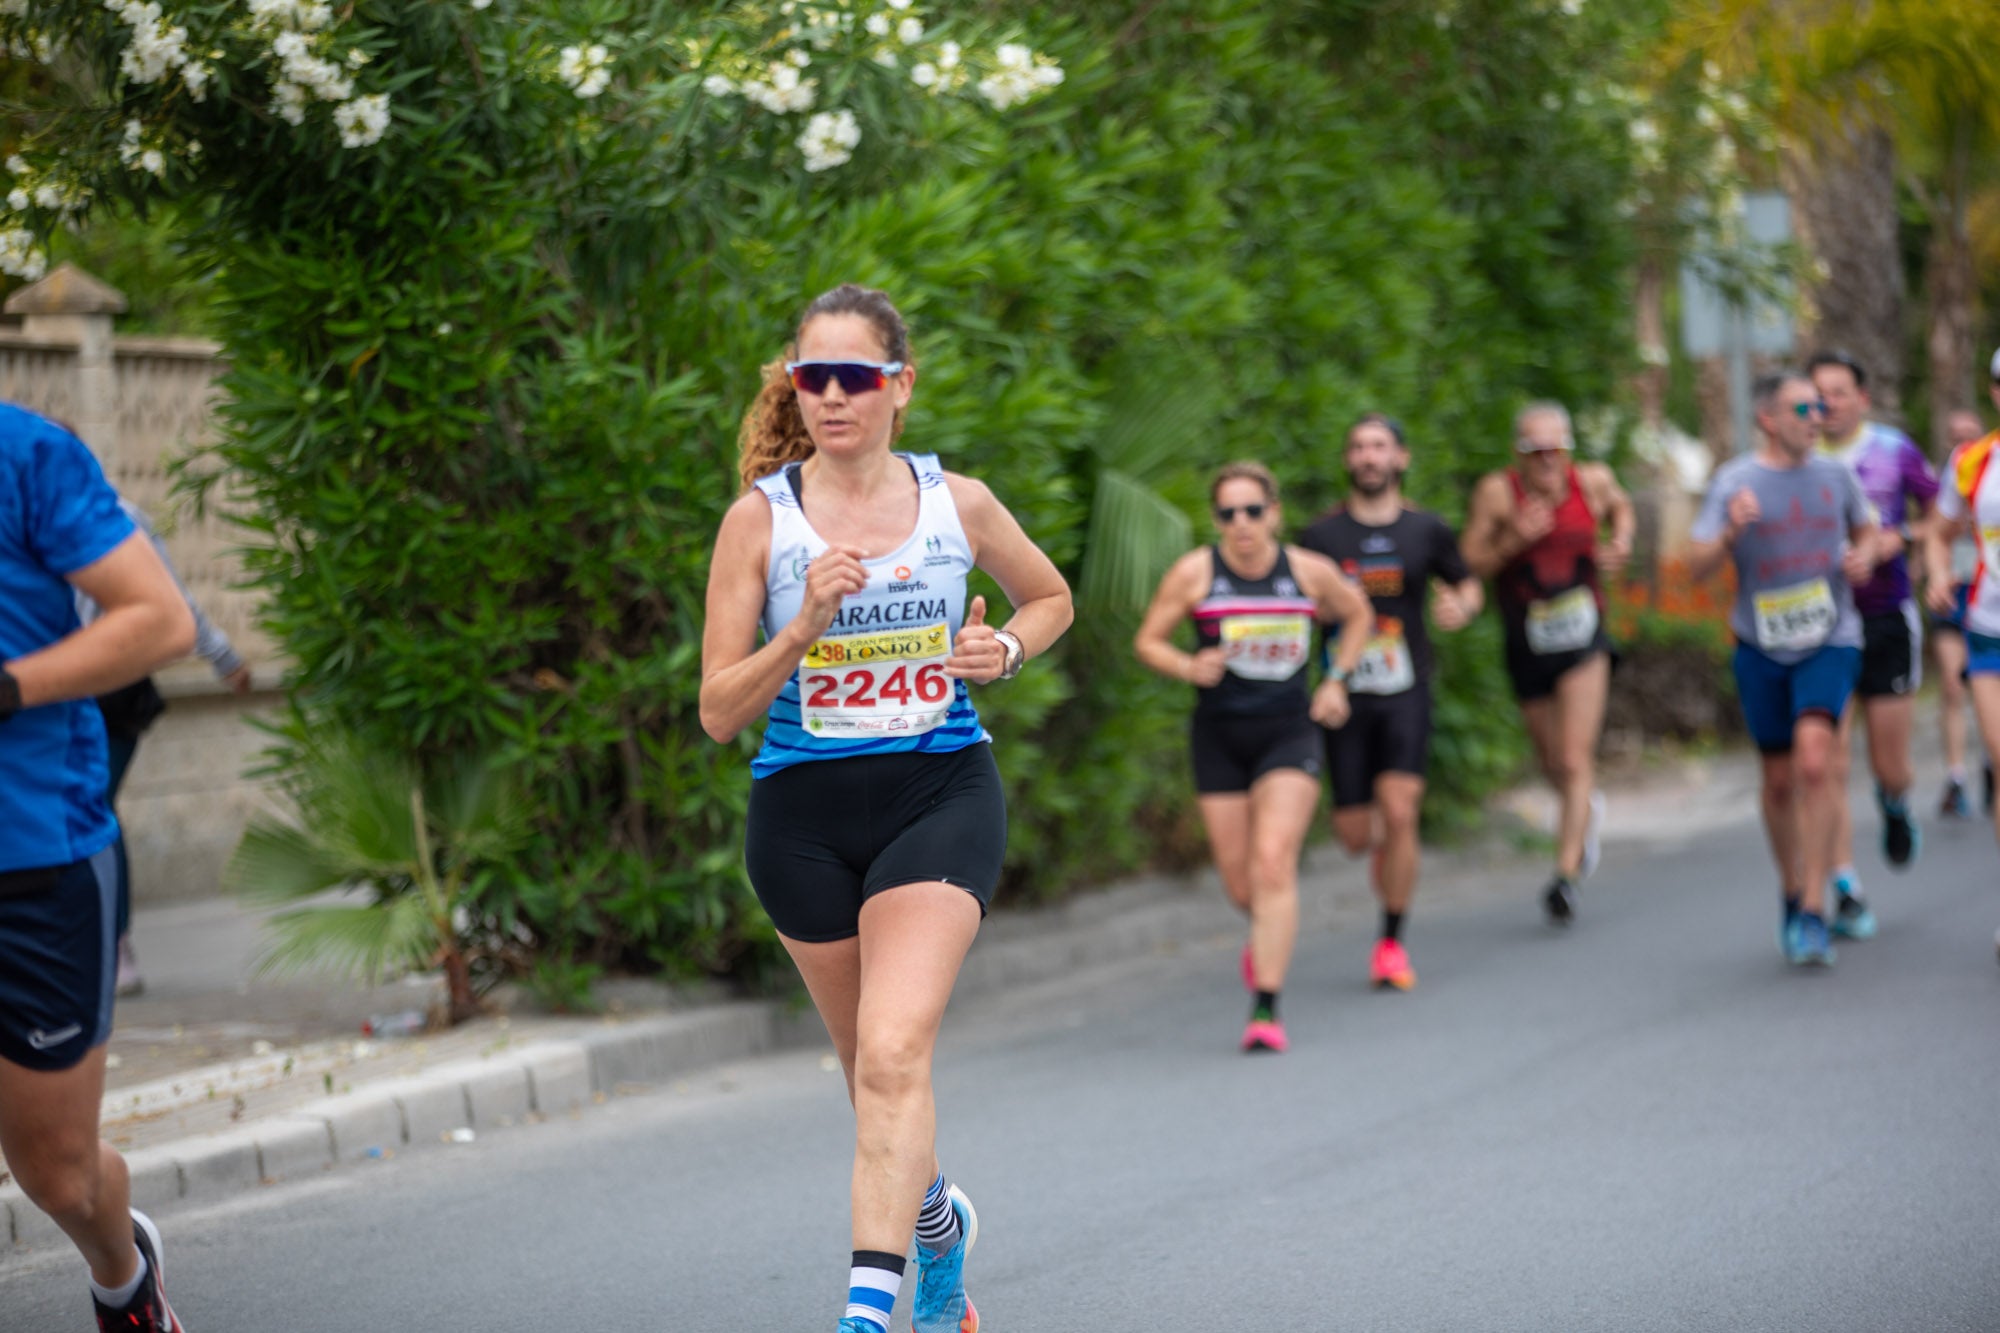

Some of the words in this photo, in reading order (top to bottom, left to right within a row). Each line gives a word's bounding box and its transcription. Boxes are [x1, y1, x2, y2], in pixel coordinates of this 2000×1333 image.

[849, 639, 876, 649] GRAN
[879, 634, 913, 643] PREMIO
[821, 643, 845, 662] 38
[846, 642, 921, 661] FONDO
[807, 664, 947, 707] 2246
